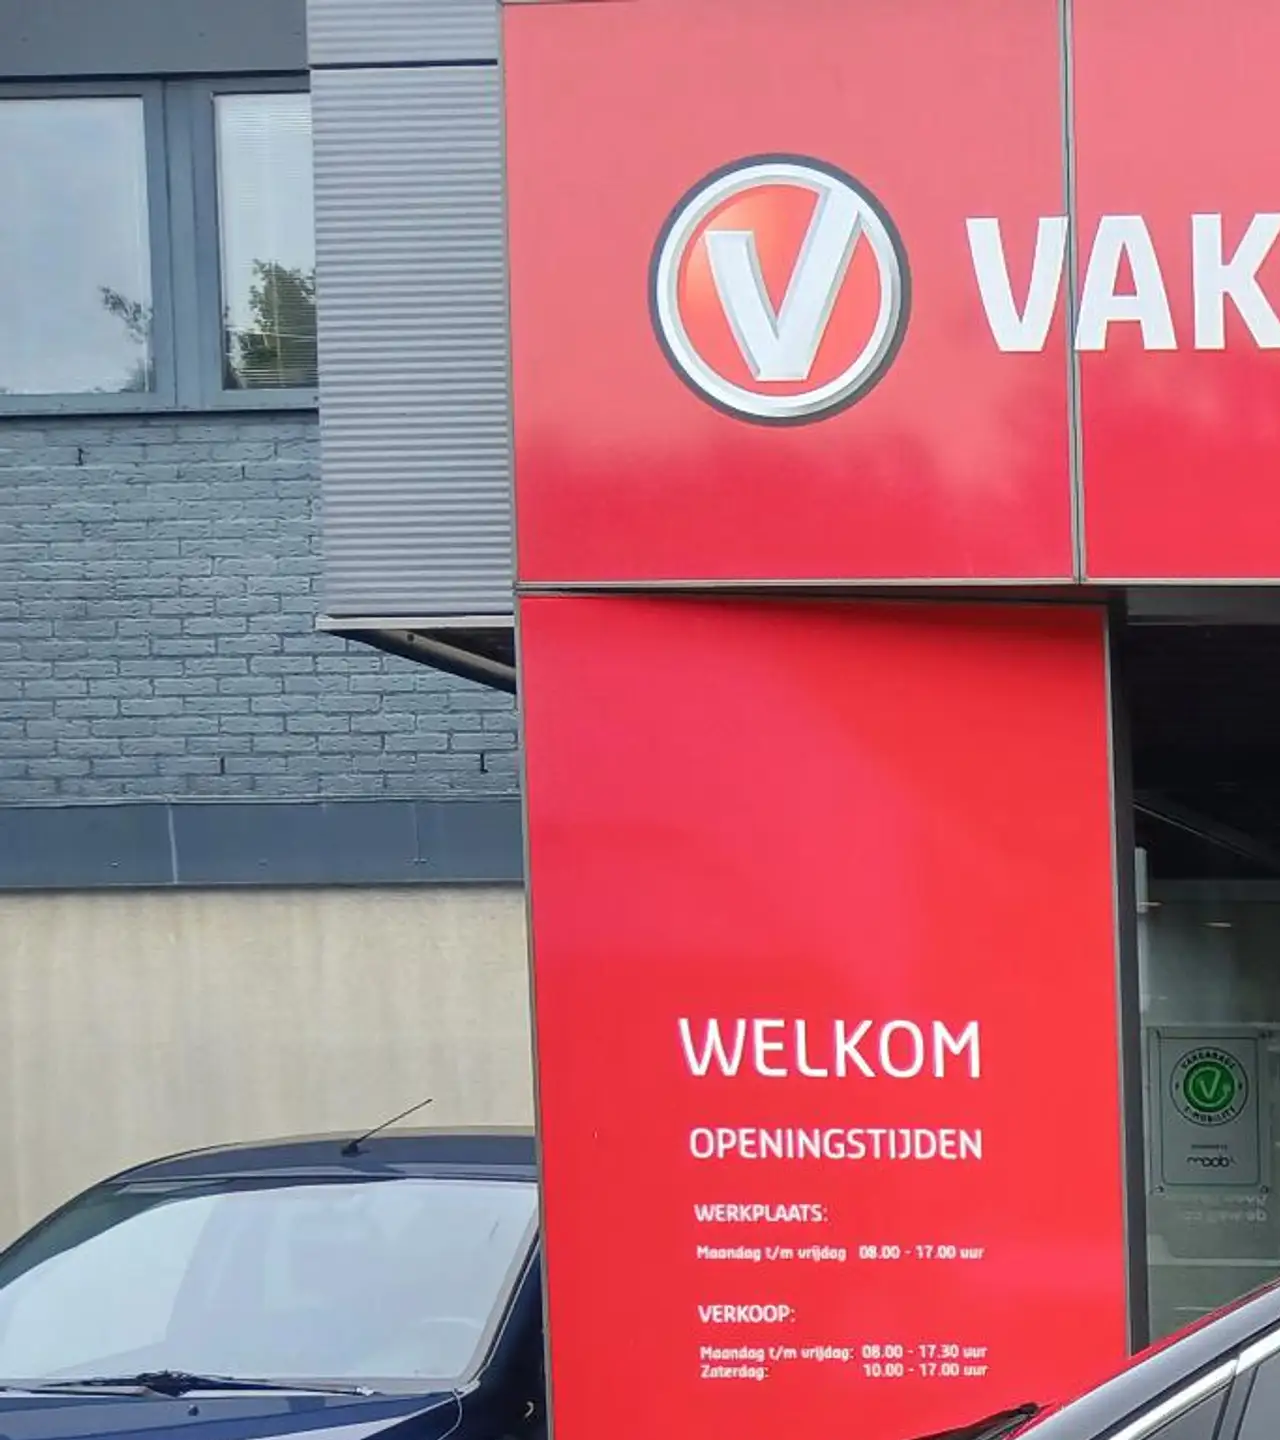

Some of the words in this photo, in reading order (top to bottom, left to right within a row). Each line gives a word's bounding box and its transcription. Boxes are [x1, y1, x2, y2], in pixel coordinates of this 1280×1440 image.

[678, 1018, 981, 1079] WELKOM
[689, 1127, 983, 1161] OPENINGSTIJDEN
[694, 1203, 829, 1223] WERKPLAATS:
[696, 1245, 762, 1262] Maandag
[766, 1245, 793, 1260] t/m
[798, 1245, 847, 1262] vrijdag
[859, 1244, 901, 1260] 08.00
[916, 1244, 957, 1259] 17.00
[960, 1248, 985, 1259] uur
[698, 1304, 796, 1324] VERKOOP:
[700, 1346, 765, 1362] Maandag
[769, 1346, 797, 1360] t/m
[802, 1345, 855, 1362] vrijdag:
[861, 1344, 904, 1359] 08.00
[919, 1344, 960, 1359] 17.30
[963, 1347, 988, 1359] uur
[701, 1364, 770, 1382] Zaterdag:
[864, 1363, 905, 1378] 10.00
[919, 1363, 960, 1377] 17.00
[963, 1366, 989, 1377] uur
